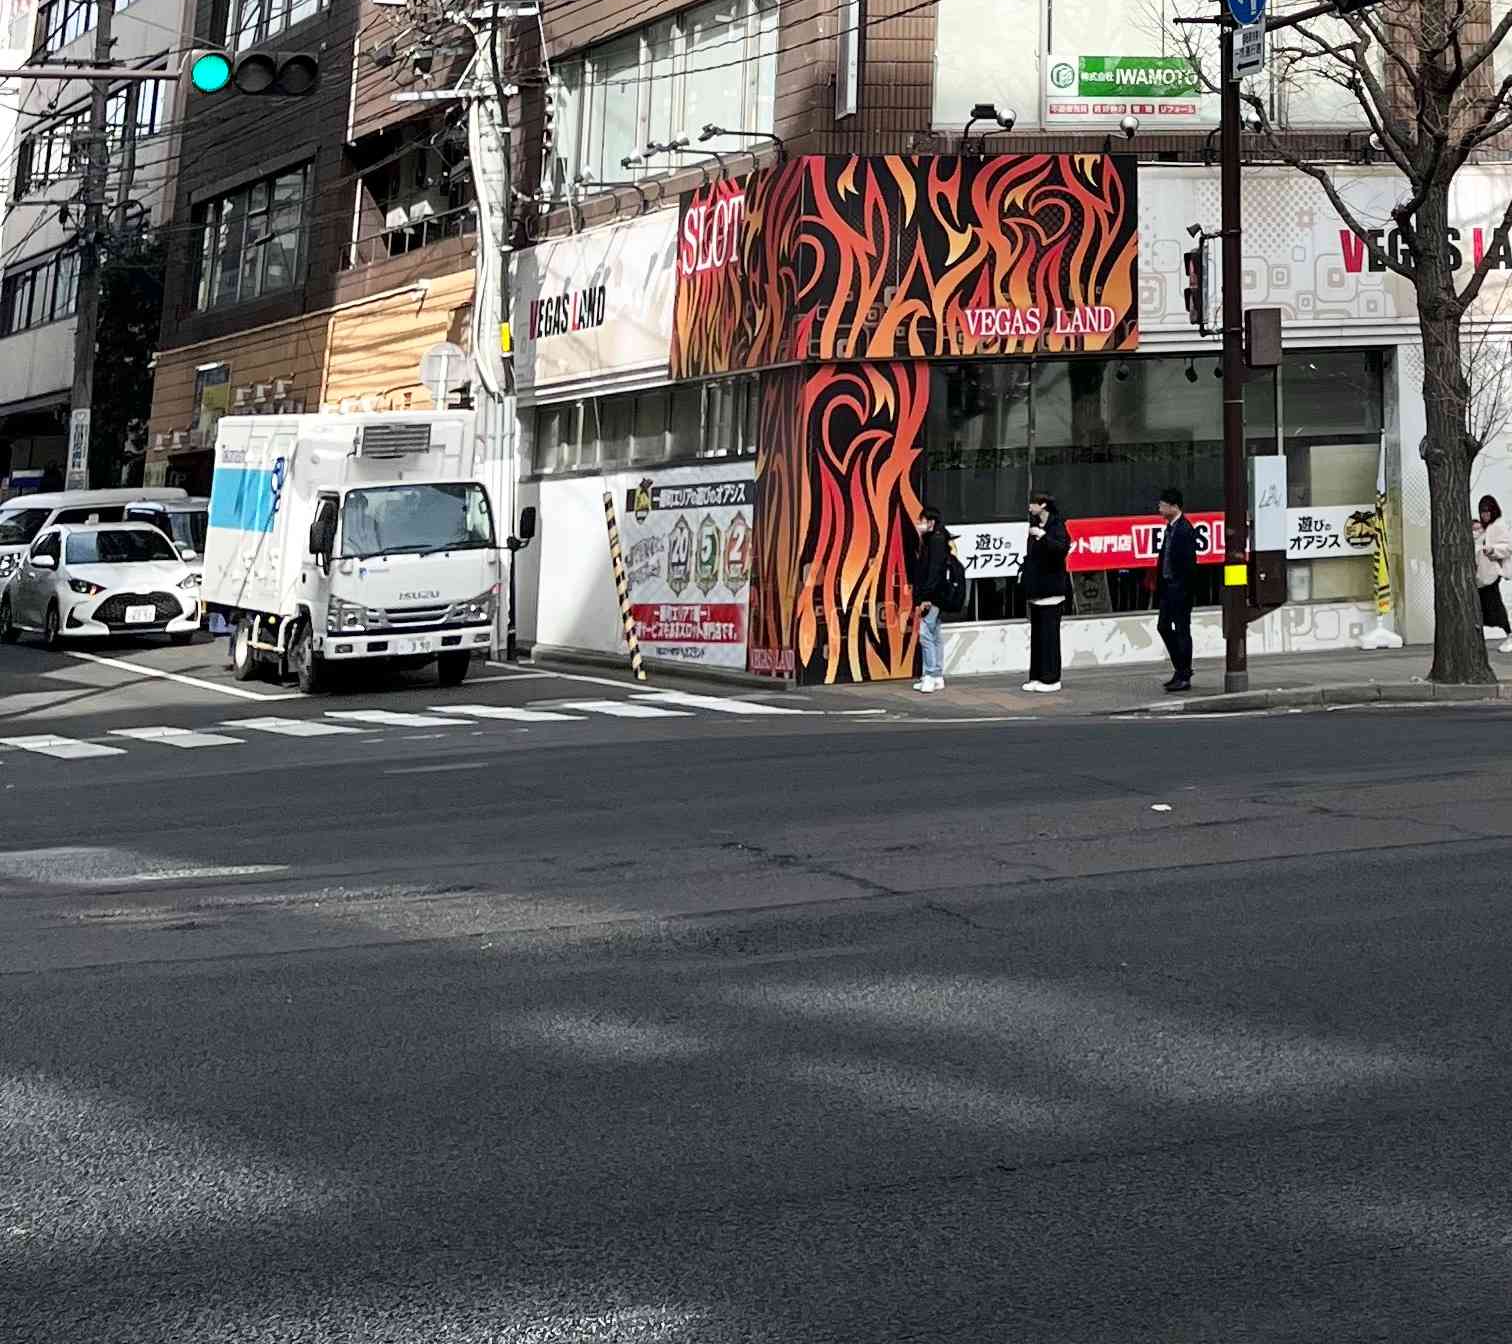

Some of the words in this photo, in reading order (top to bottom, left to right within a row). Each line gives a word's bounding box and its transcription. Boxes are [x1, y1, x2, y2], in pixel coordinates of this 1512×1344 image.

[681, 192, 746, 277] SLOT
[528, 291, 569, 341] VEGAS
[571, 285, 606, 331] LAND
[964, 308, 1042, 337] VEGAS
[1055, 306, 1116, 335] LAND
[1297, 516, 1332, 533] 遊びの
[975, 533, 1012, 551] 遊びの
[1289, 533, 1341, 551] オアシス
[965, 552, 1022, 570] オアシス
